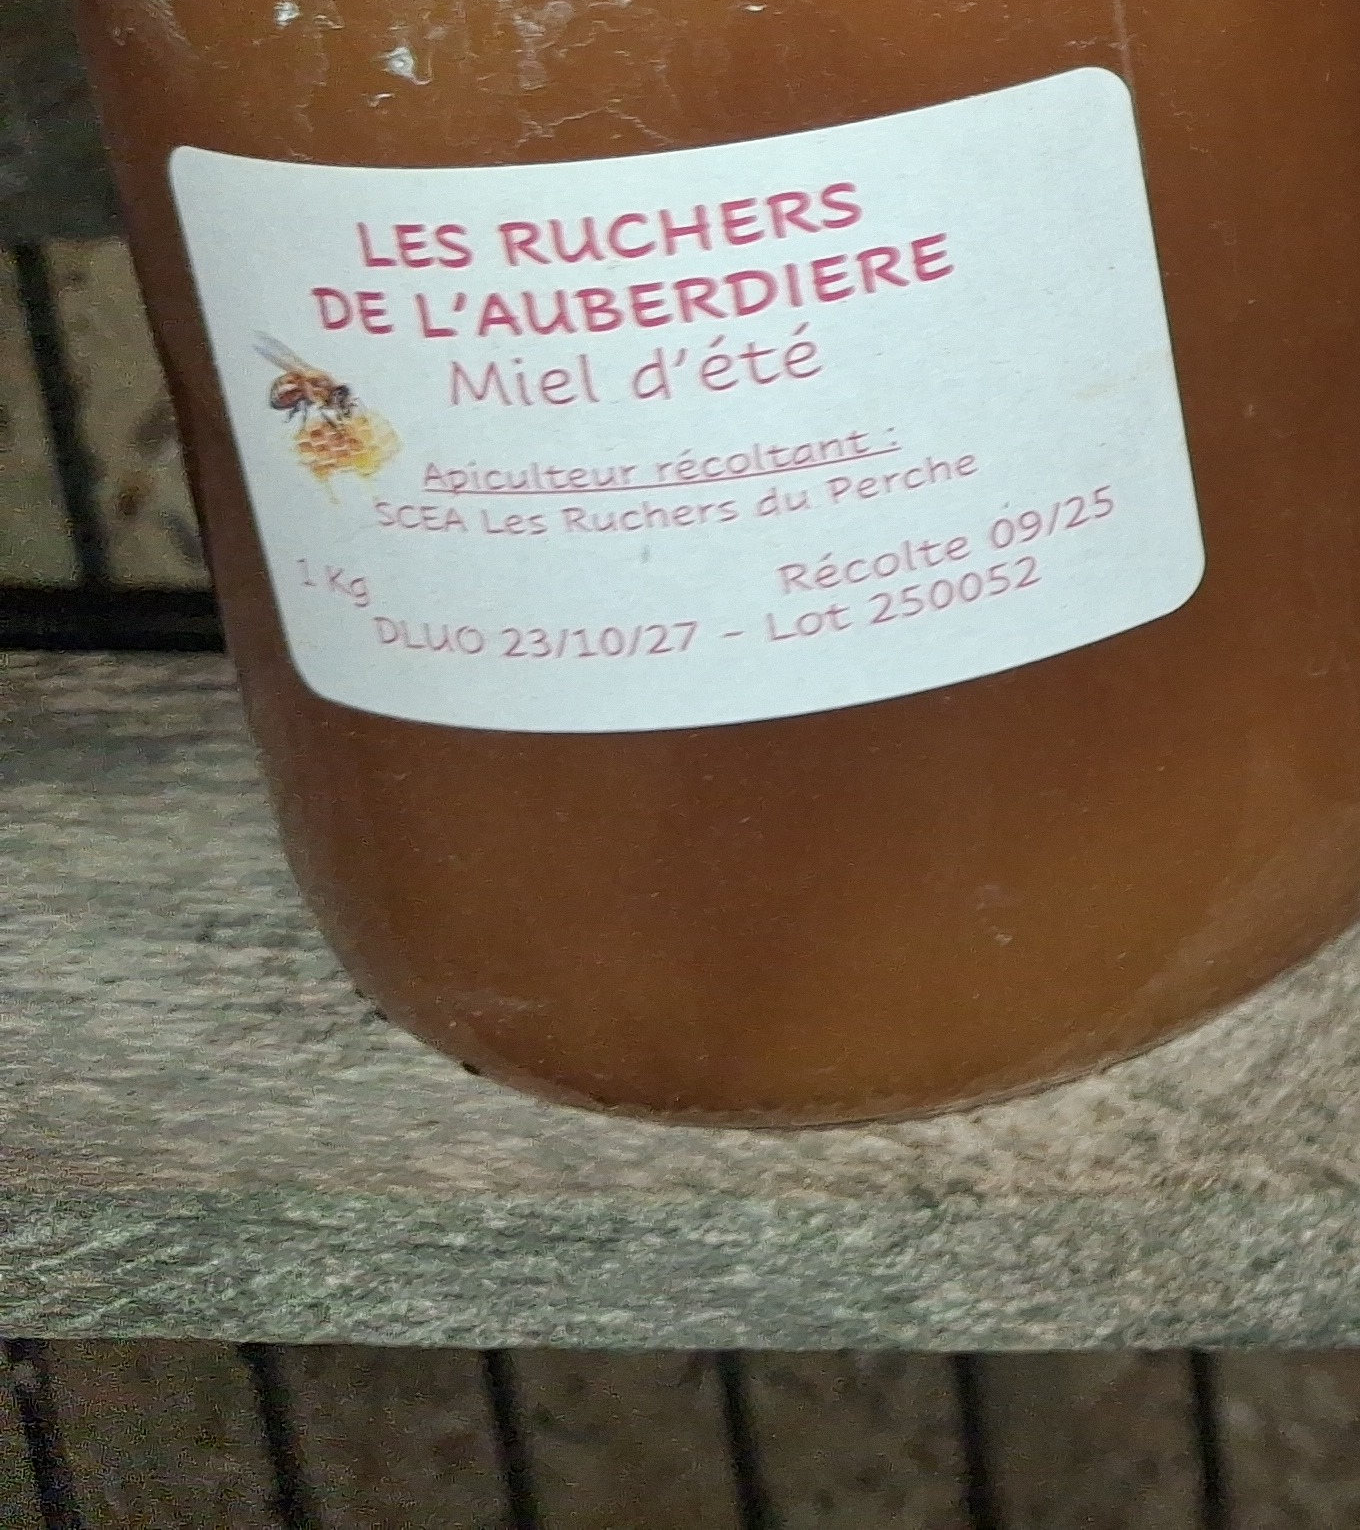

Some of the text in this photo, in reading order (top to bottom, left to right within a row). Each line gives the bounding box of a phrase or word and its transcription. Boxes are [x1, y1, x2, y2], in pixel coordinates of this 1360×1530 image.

[357, 182, 864, 270] LES RUCHERS
[309, 285, 395, 336] DE
[449, 352, 597, 409] Miel
[373, 449, 979, 536] SCEA Les Ruchers du Perche
[422, 457, 638, 495] Apiculteur
[653, 428, 874, 486] récoltant
[778, 486, 1115, 595] Récolte 09/25
[298, 560, 371, 608] 1 Kg
[373, 618, 484, 657] DLUO
[499, 620, 698, 659] 23/10/27
[766, 601, 852, 642] Lot
[871, 558, 1042, 627] 250052
